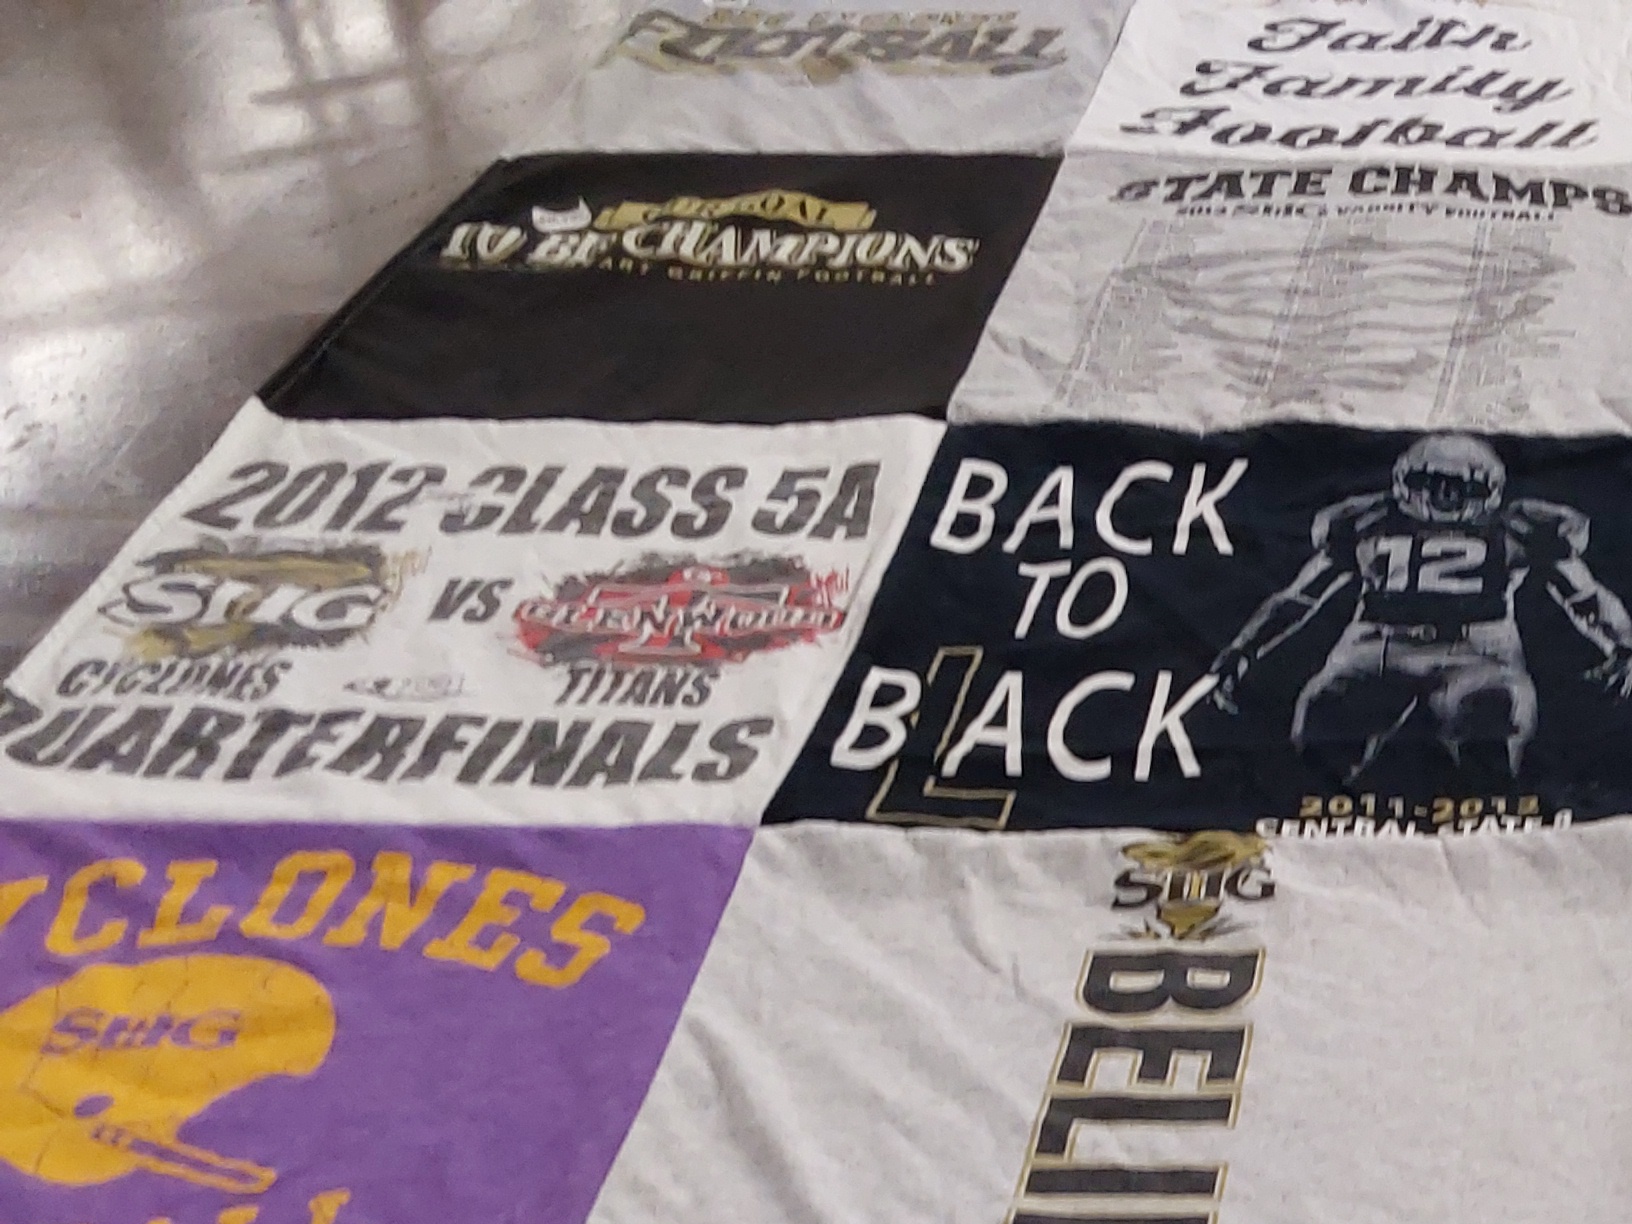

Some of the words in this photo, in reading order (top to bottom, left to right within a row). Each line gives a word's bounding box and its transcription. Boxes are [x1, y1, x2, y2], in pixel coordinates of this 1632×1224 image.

[1248, 15, 1532, 53] Faith
[1179, 59, 1573, 114] Family
[1120, 105, 1597, 150] Football
[1110, 166, 1335, 204] STATE
[622, 217, 982, 273] CHAMPIONS
[181, 459, 448, 533] 2012
[440, 462, 748, 539] CLASS
[751, 461, 884, 541] 5A
[931, 457, 1249, 556] BACK
[1372, 534, 1488, 594] 12
[428, 578, 511, 624] VS
[1013, 555, 1130, 640] TO
[57, 660, 293, 702] CYCLONES
[554, 665, 722, 709] TITANS
